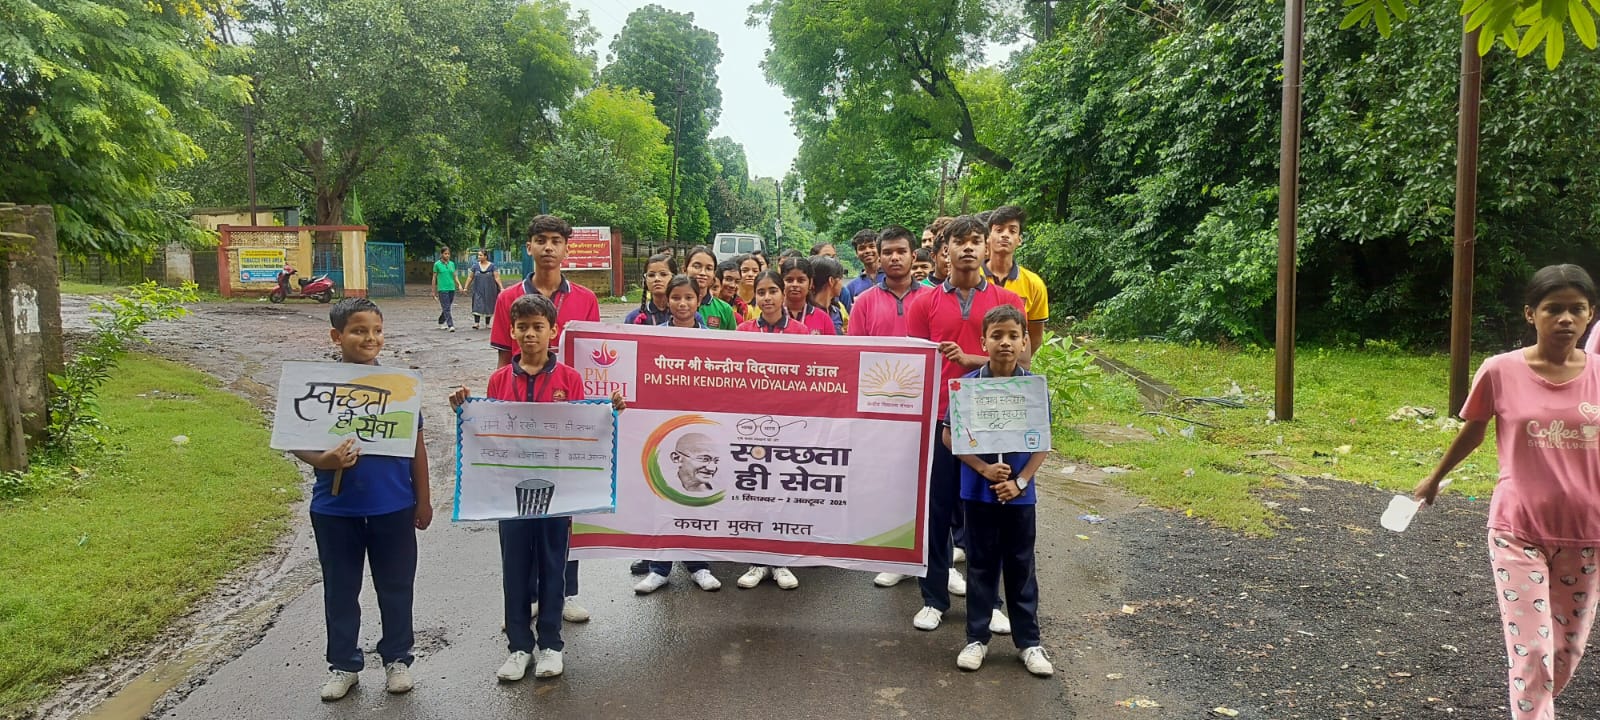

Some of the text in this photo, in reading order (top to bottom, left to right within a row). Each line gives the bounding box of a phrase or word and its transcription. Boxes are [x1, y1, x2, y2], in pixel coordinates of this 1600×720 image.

[584, 368, 609, 381] PM
[654, 354, 839, 378] पीएम श्री केन्द्रीय विद्यालय अंडाल
[584, 381, 628, 397] SHRI
[644, 372, 848, 394] PM SHRI KENDRIYA VIDYALAYA ANDAL
[294, 382, 392, 422] स्वच्छता
[335, 409, 399, 443] ही सेवा
[1526, 419, 1580, 443] Coffee
[729, 442, 853, 467] स्वच्छता
[734, 463, 846, 493] ही सेवा
[673, 518, 814, 536] कचरा मुक्त भारत
